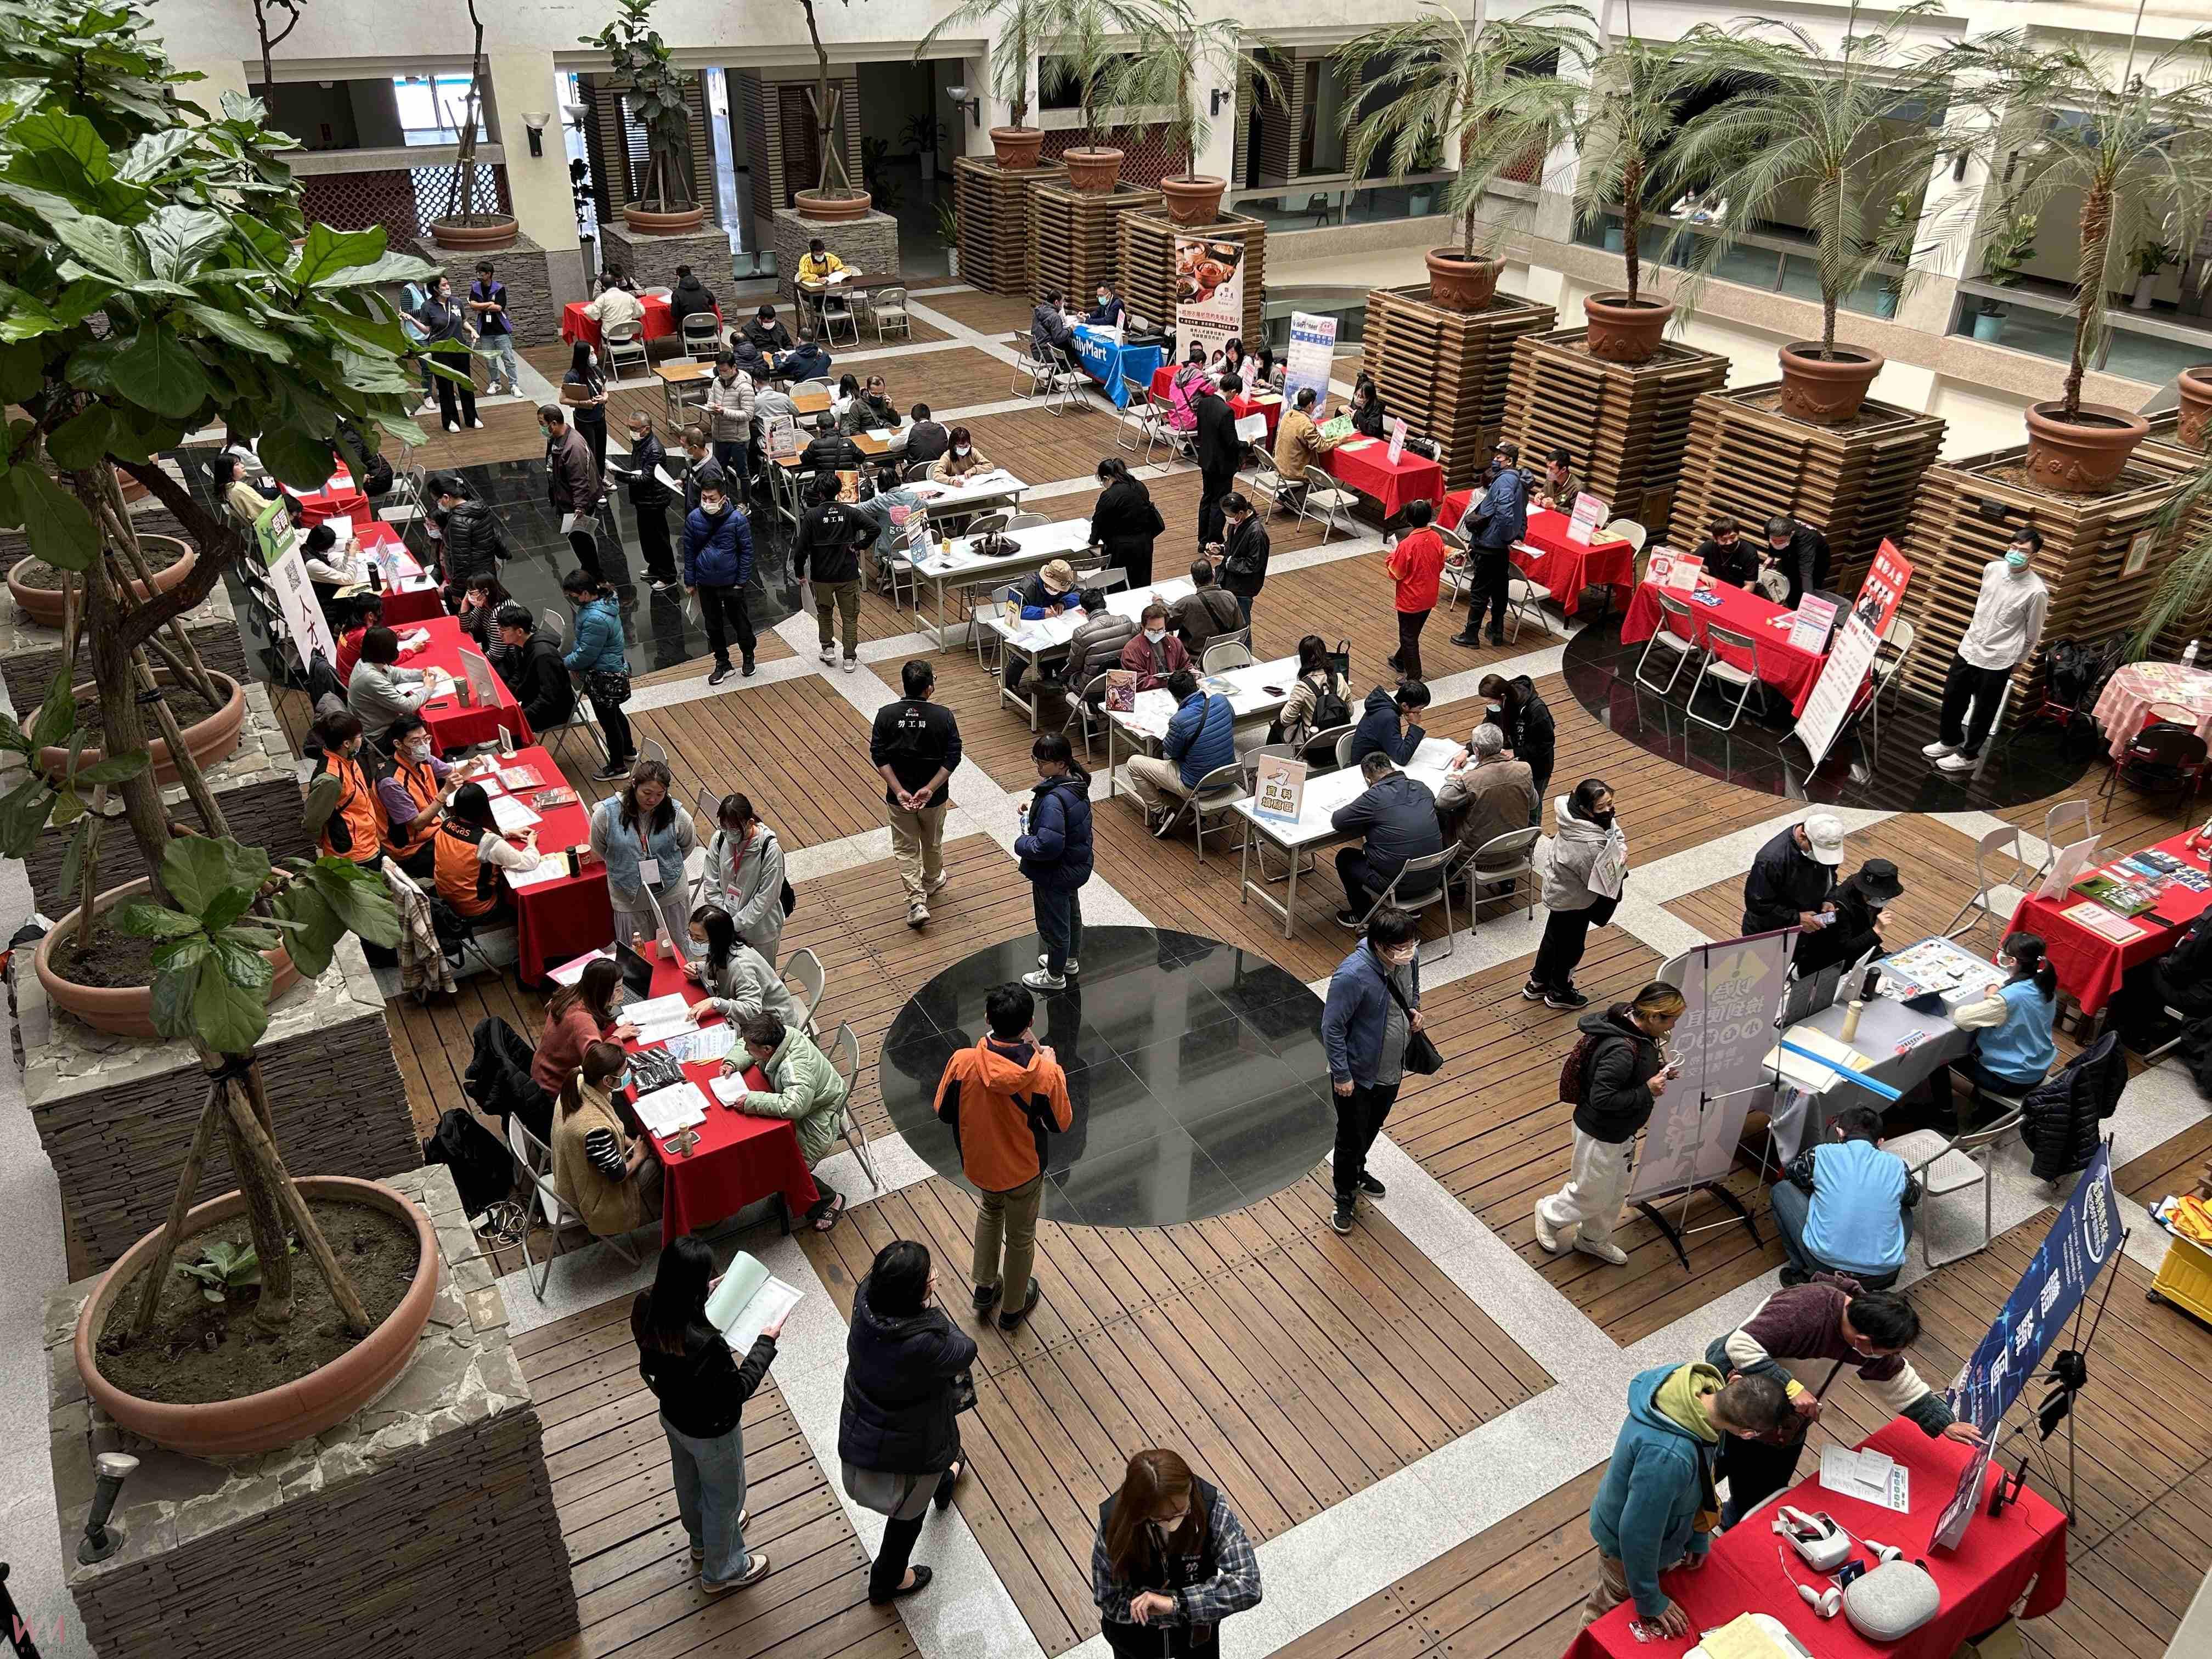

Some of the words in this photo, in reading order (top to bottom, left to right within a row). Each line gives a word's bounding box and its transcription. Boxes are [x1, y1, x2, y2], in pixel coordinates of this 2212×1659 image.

[898, 720, 926, 729] 勞工局
[1266, 785, 1292, 800] 資料
[1261, 797, 1294, 812] 填寫區
[1991, 1267, 2061, 1395] 體驗區
